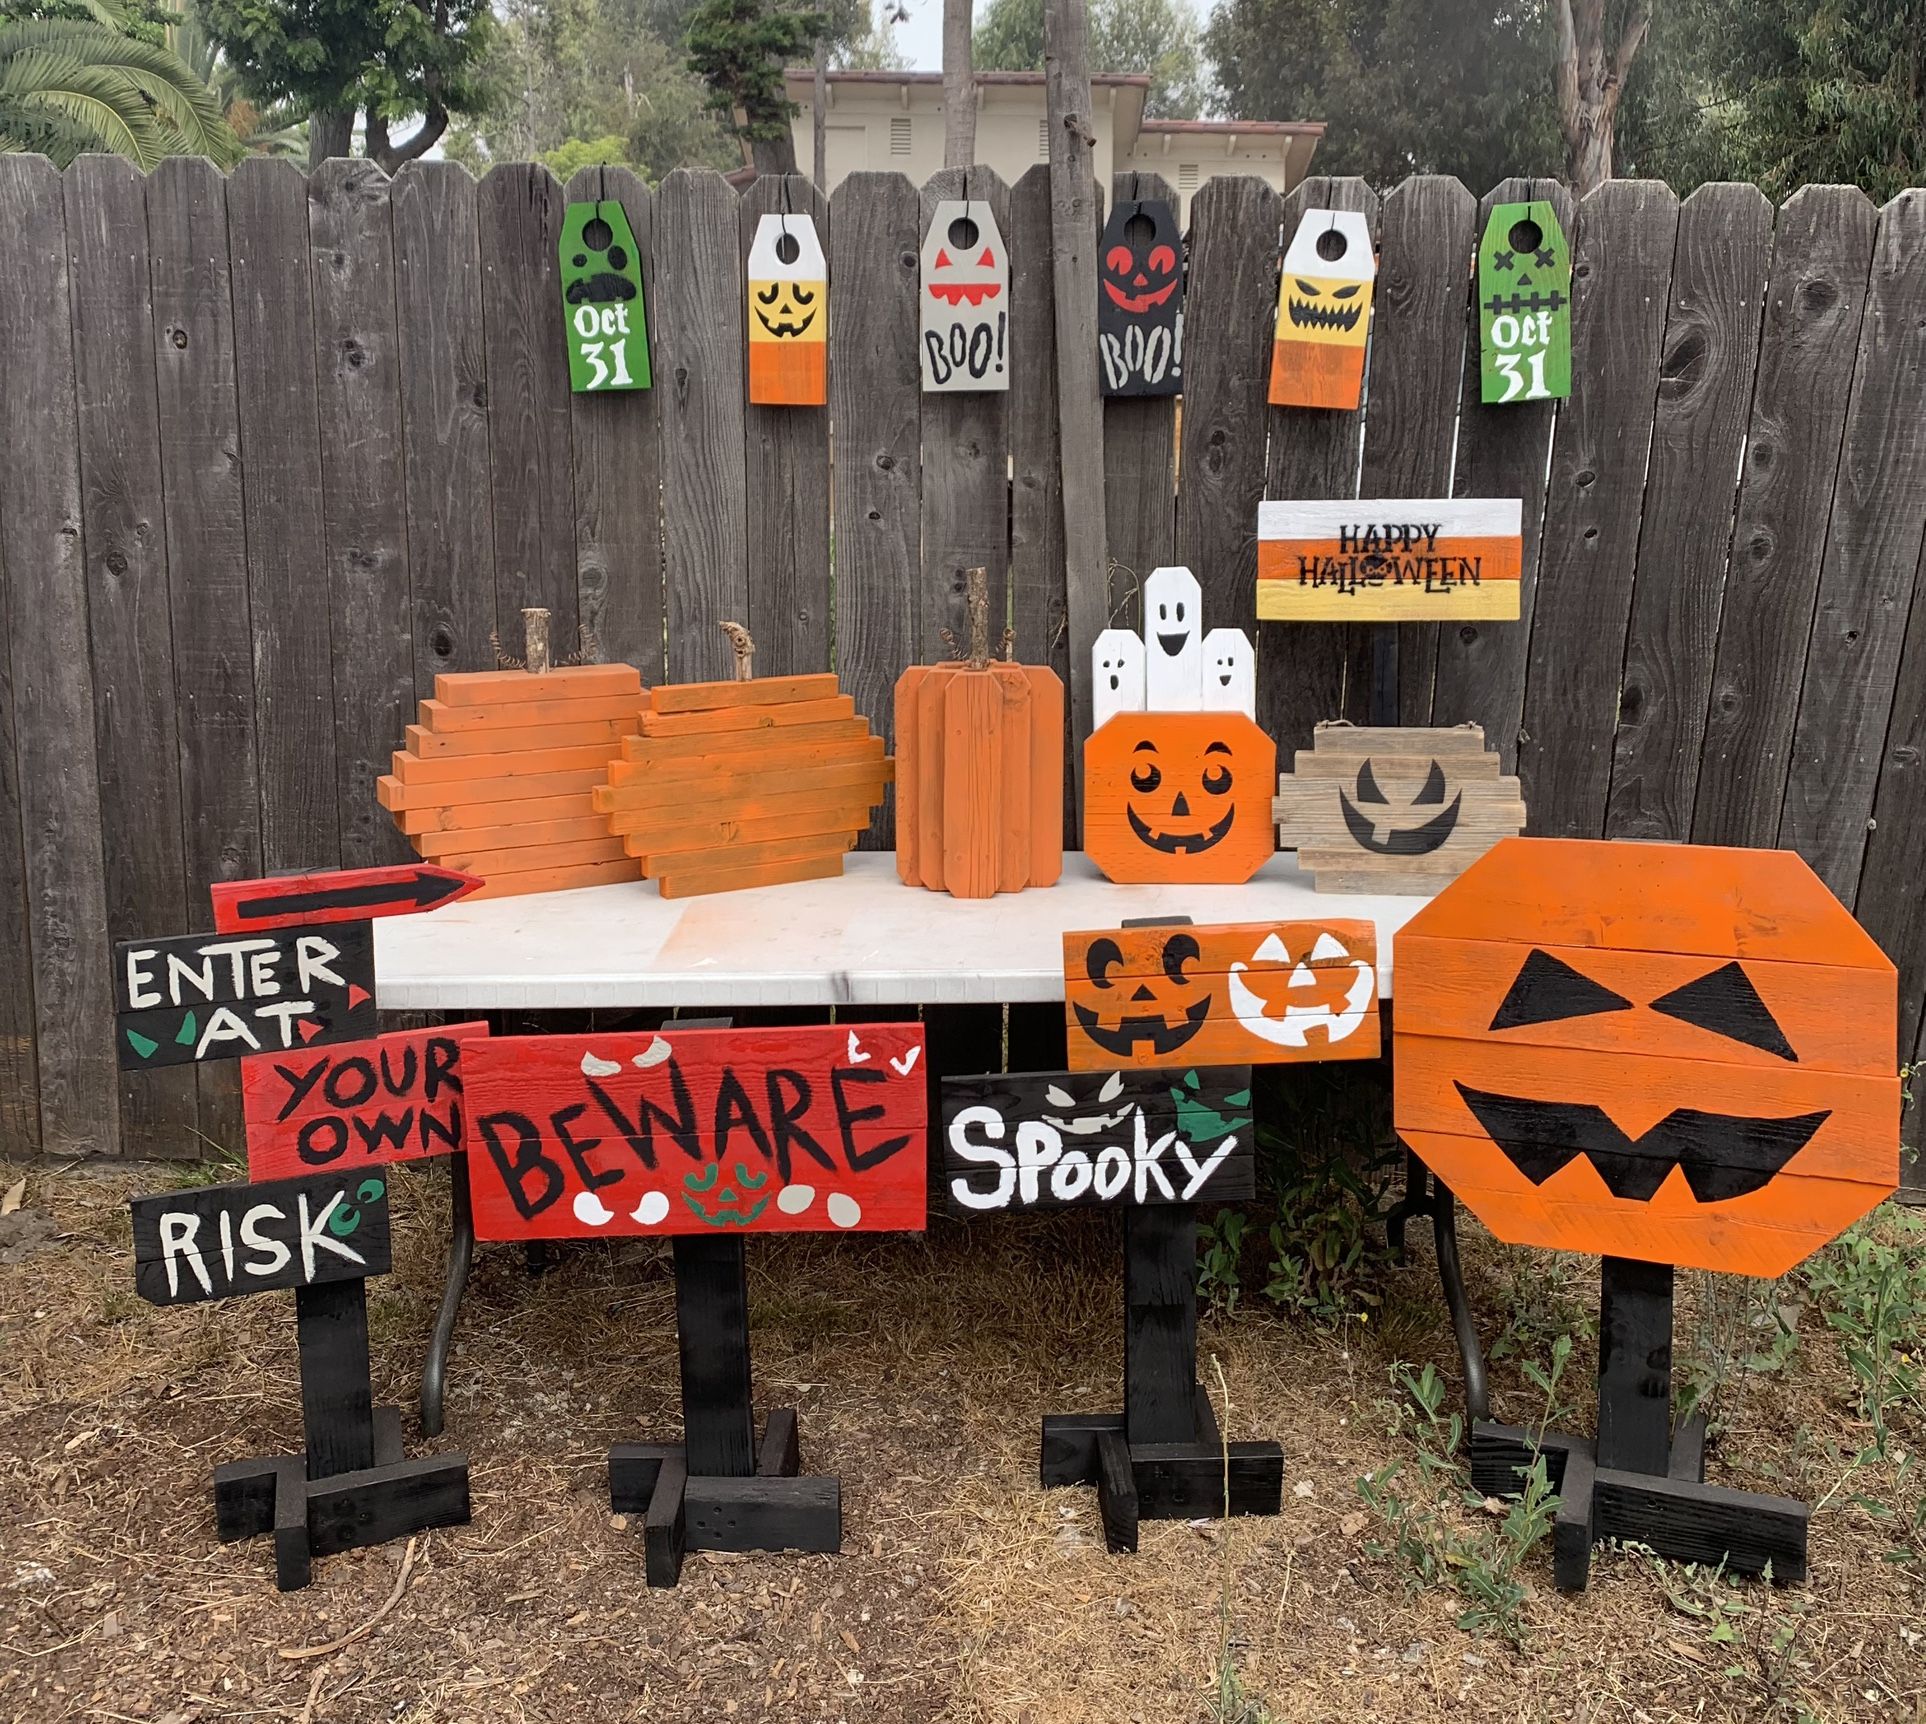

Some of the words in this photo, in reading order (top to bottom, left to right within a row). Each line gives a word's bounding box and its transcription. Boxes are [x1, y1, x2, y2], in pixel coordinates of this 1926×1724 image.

[573, 303, 631, 337] Oct
[925, 311, 1006, 384] BOO!
[1100, 313, 1184, 389] BOO!
[1491, 311, 1553, 348] Oct
[580, 338, 633, 389] 31
[1494, 349, 1551, 402] 31
[1339, 523, 1442, 554] HAPPY
[127, 936, 348, 1009] ENTER
[195, 1000, 316, 1059] AT
[274, 1037, 462, 1122] YOUR
[298, 1101, 460, 1164] OWN
[475, 1053, 915, 1220] BEWARE
[159, 1189, 367, 1297] RISK
